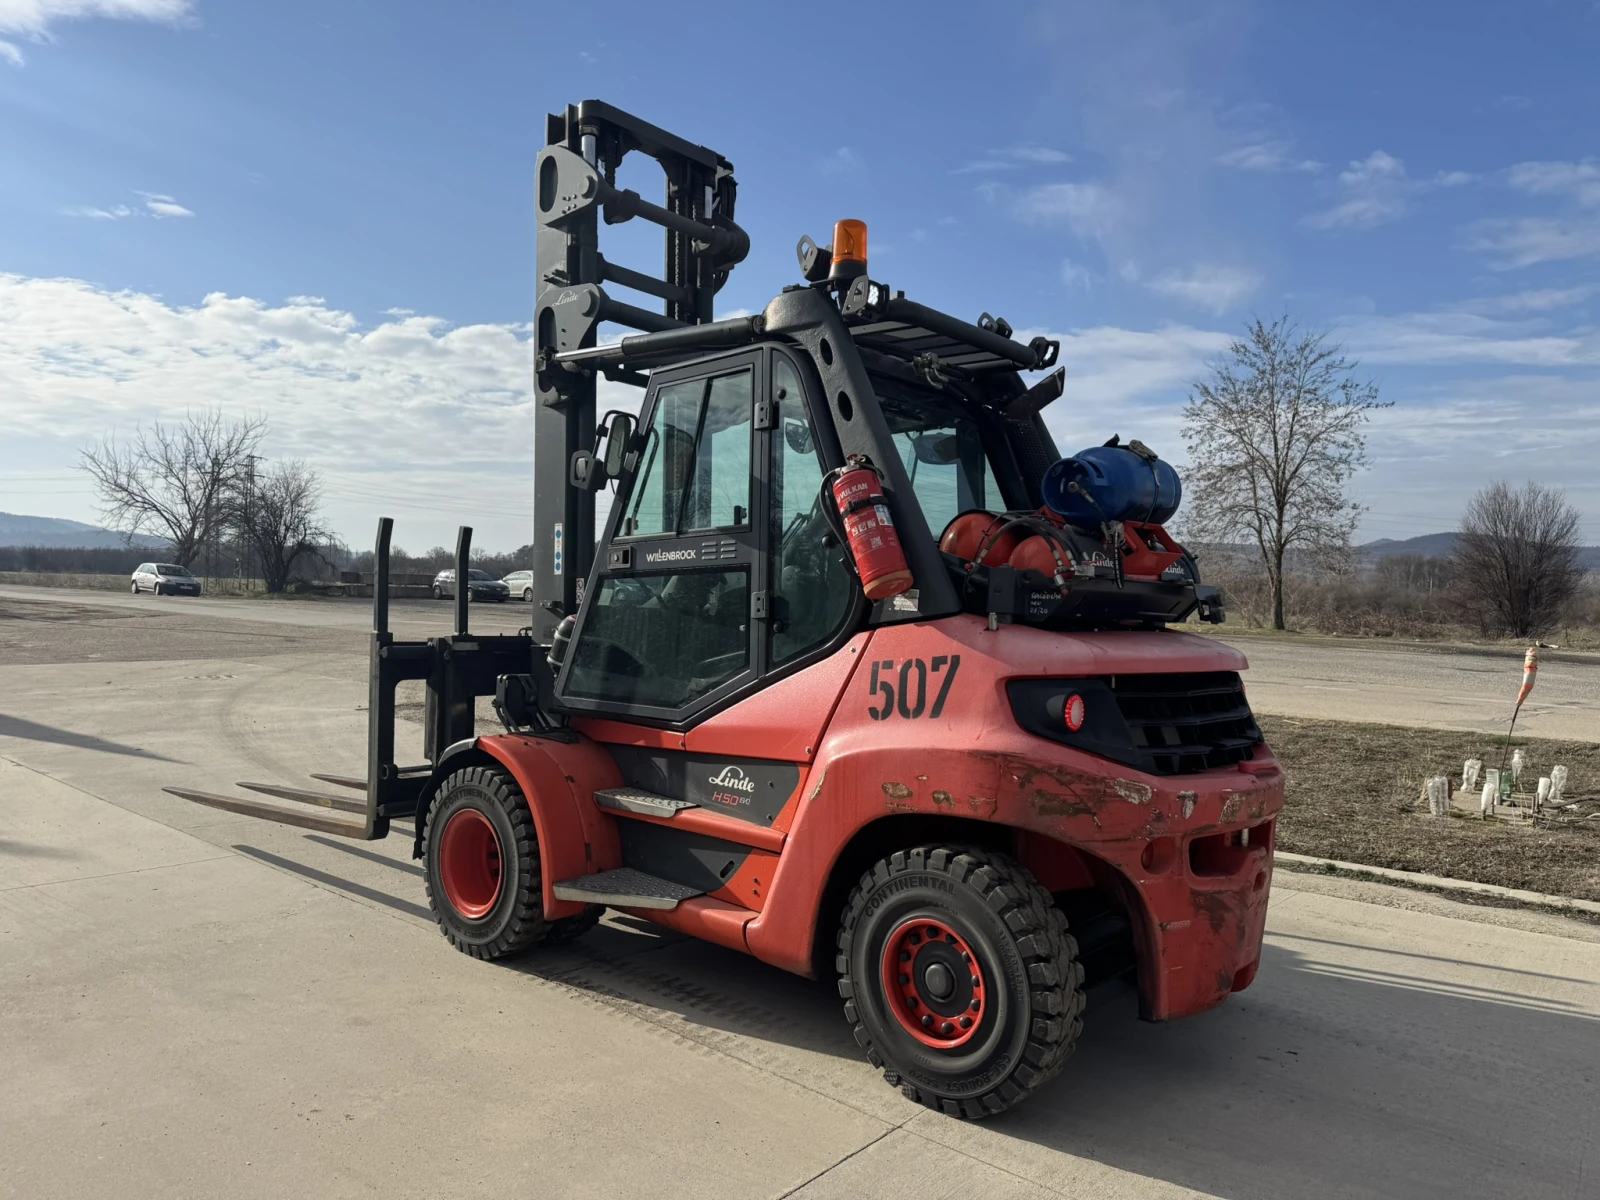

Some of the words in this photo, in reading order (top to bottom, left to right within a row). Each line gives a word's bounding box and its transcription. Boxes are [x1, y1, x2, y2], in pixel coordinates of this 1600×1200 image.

[552, 290, 579, 306] Linde
[840, 483, 868, 499] VULKAN
[646, 549, 696, 562] WILLENBROCK
[1089, 551, 1114, 568] Linde
[868, 655, 960, 720] 507
[709, 766, 754, 792] Linde
[443, 787, 496, 810] CONTINENTAL
[712, 791, 739, 806] H50
[865, 875, 957, 918] CONTINENTAL
